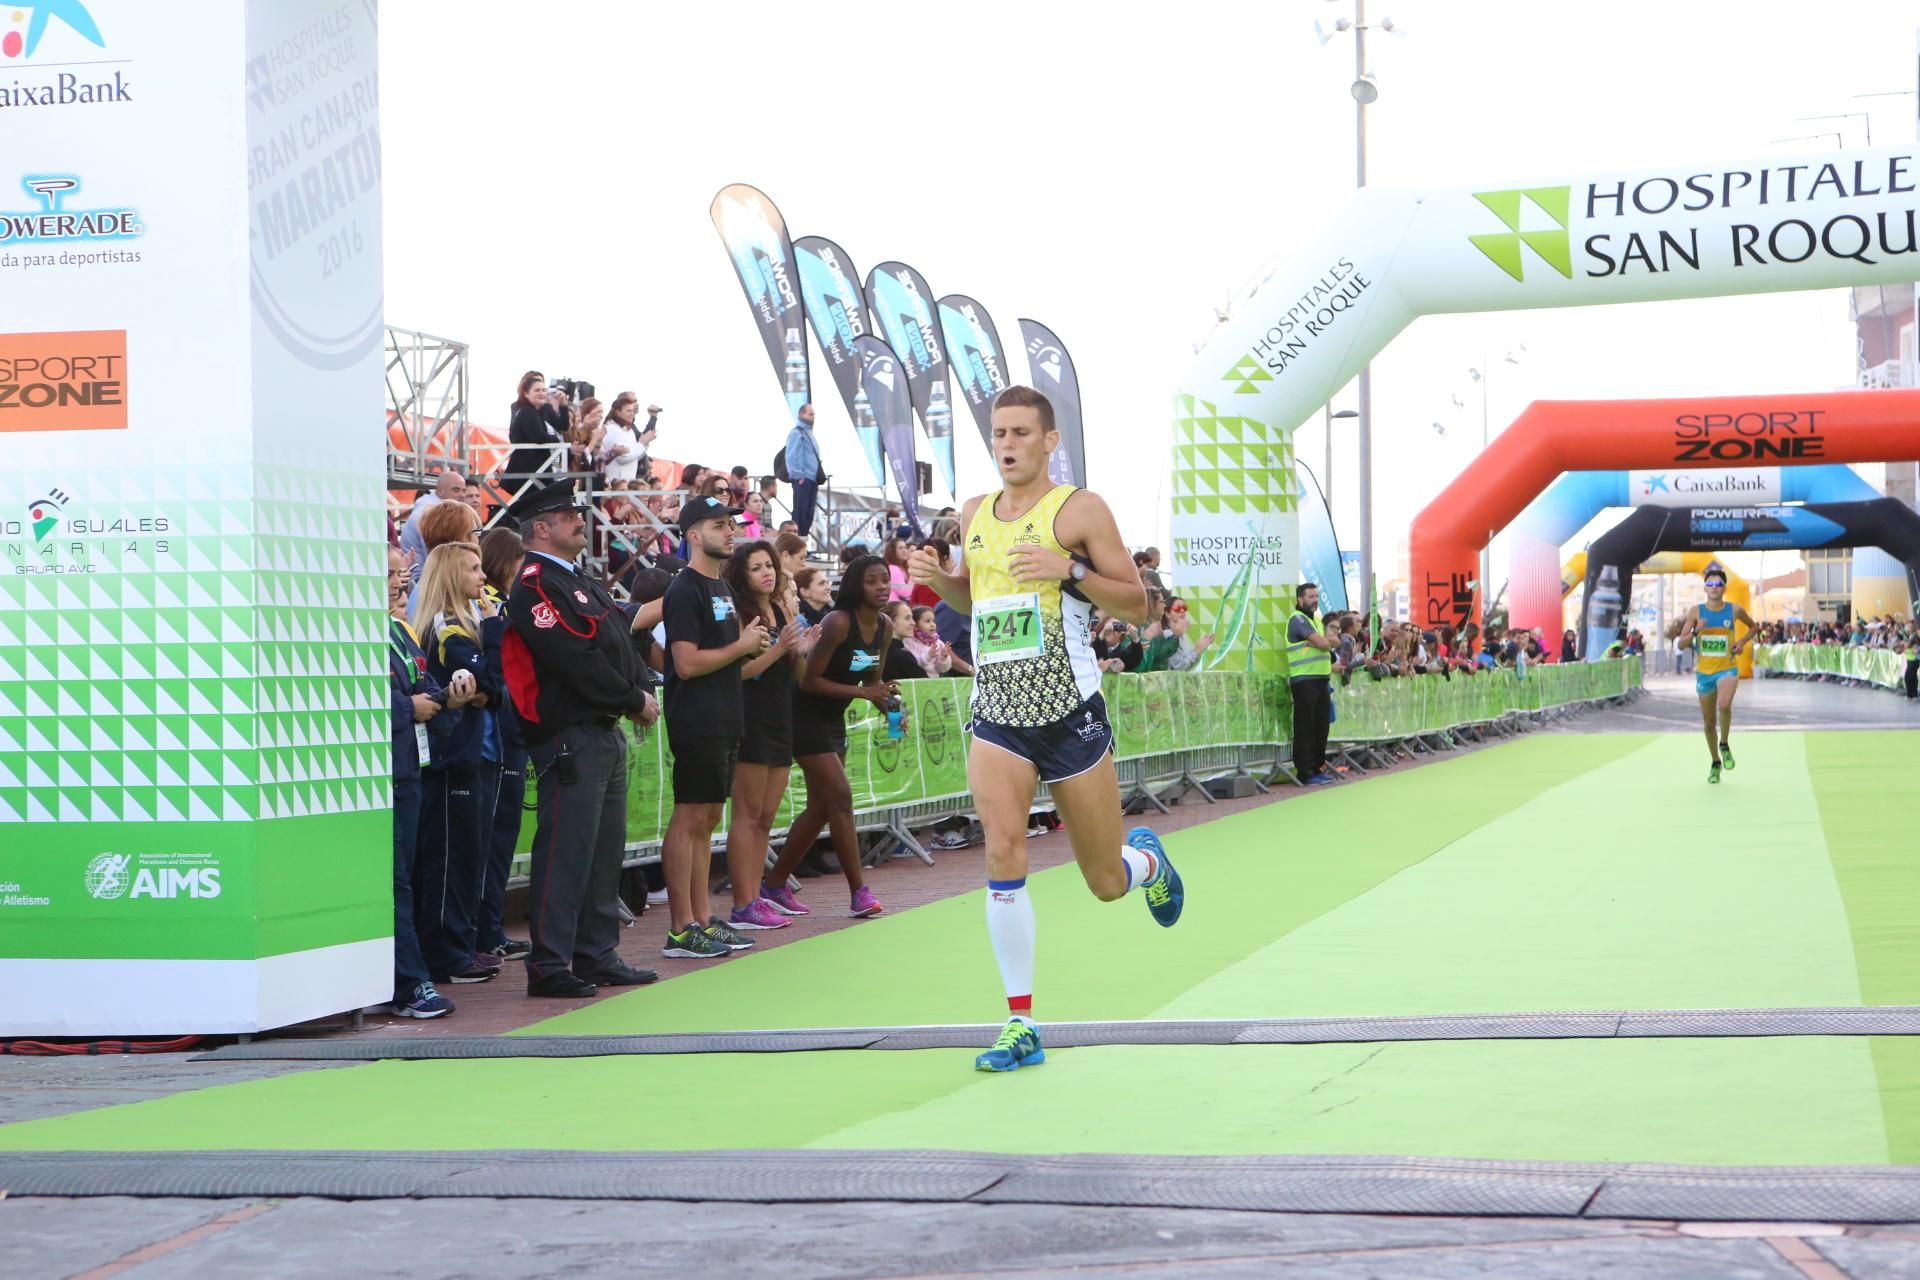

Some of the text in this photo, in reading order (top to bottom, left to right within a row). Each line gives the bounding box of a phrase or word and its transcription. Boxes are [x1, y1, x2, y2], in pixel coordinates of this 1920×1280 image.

[269, 5, 352, 73] HOSPITALES
[276, 35, 358, 105] SAN ROQUE
[1585, 155, 1917, 219] HOSPITALE
[317, 219, 363, 280] 2016
[1584, 209, 1919, 277] SAN ROQU
[1, 249, 141, 270] da para deportistas
[1252, 256, 1354, 359] HOSPITALES
[1268, 272, 1371, 375] SAN ROQUE
[1675, 410, 1826, 438] SPORT
[1674, 436, 1825, 461] ZONE
[1674, 475, 1767, 492] CaixaBank
[1691, 507, 1795, 519] POWERADE
[1014, 534, 1041, 545] HPS
[15, 564, 96, 575] GRUPO AVC
[1191, 553, 1219, 566] SAN
[1427, 571, 1450, 624] RT
[978, 611, 1033, 643] 9247
[1702, 641, 1726, 649] 8229
[1077, 721, 1104, 736] HPS
[129, 867, 221, 899] AIMS
[3, 895, 50, 906] Atletismo
